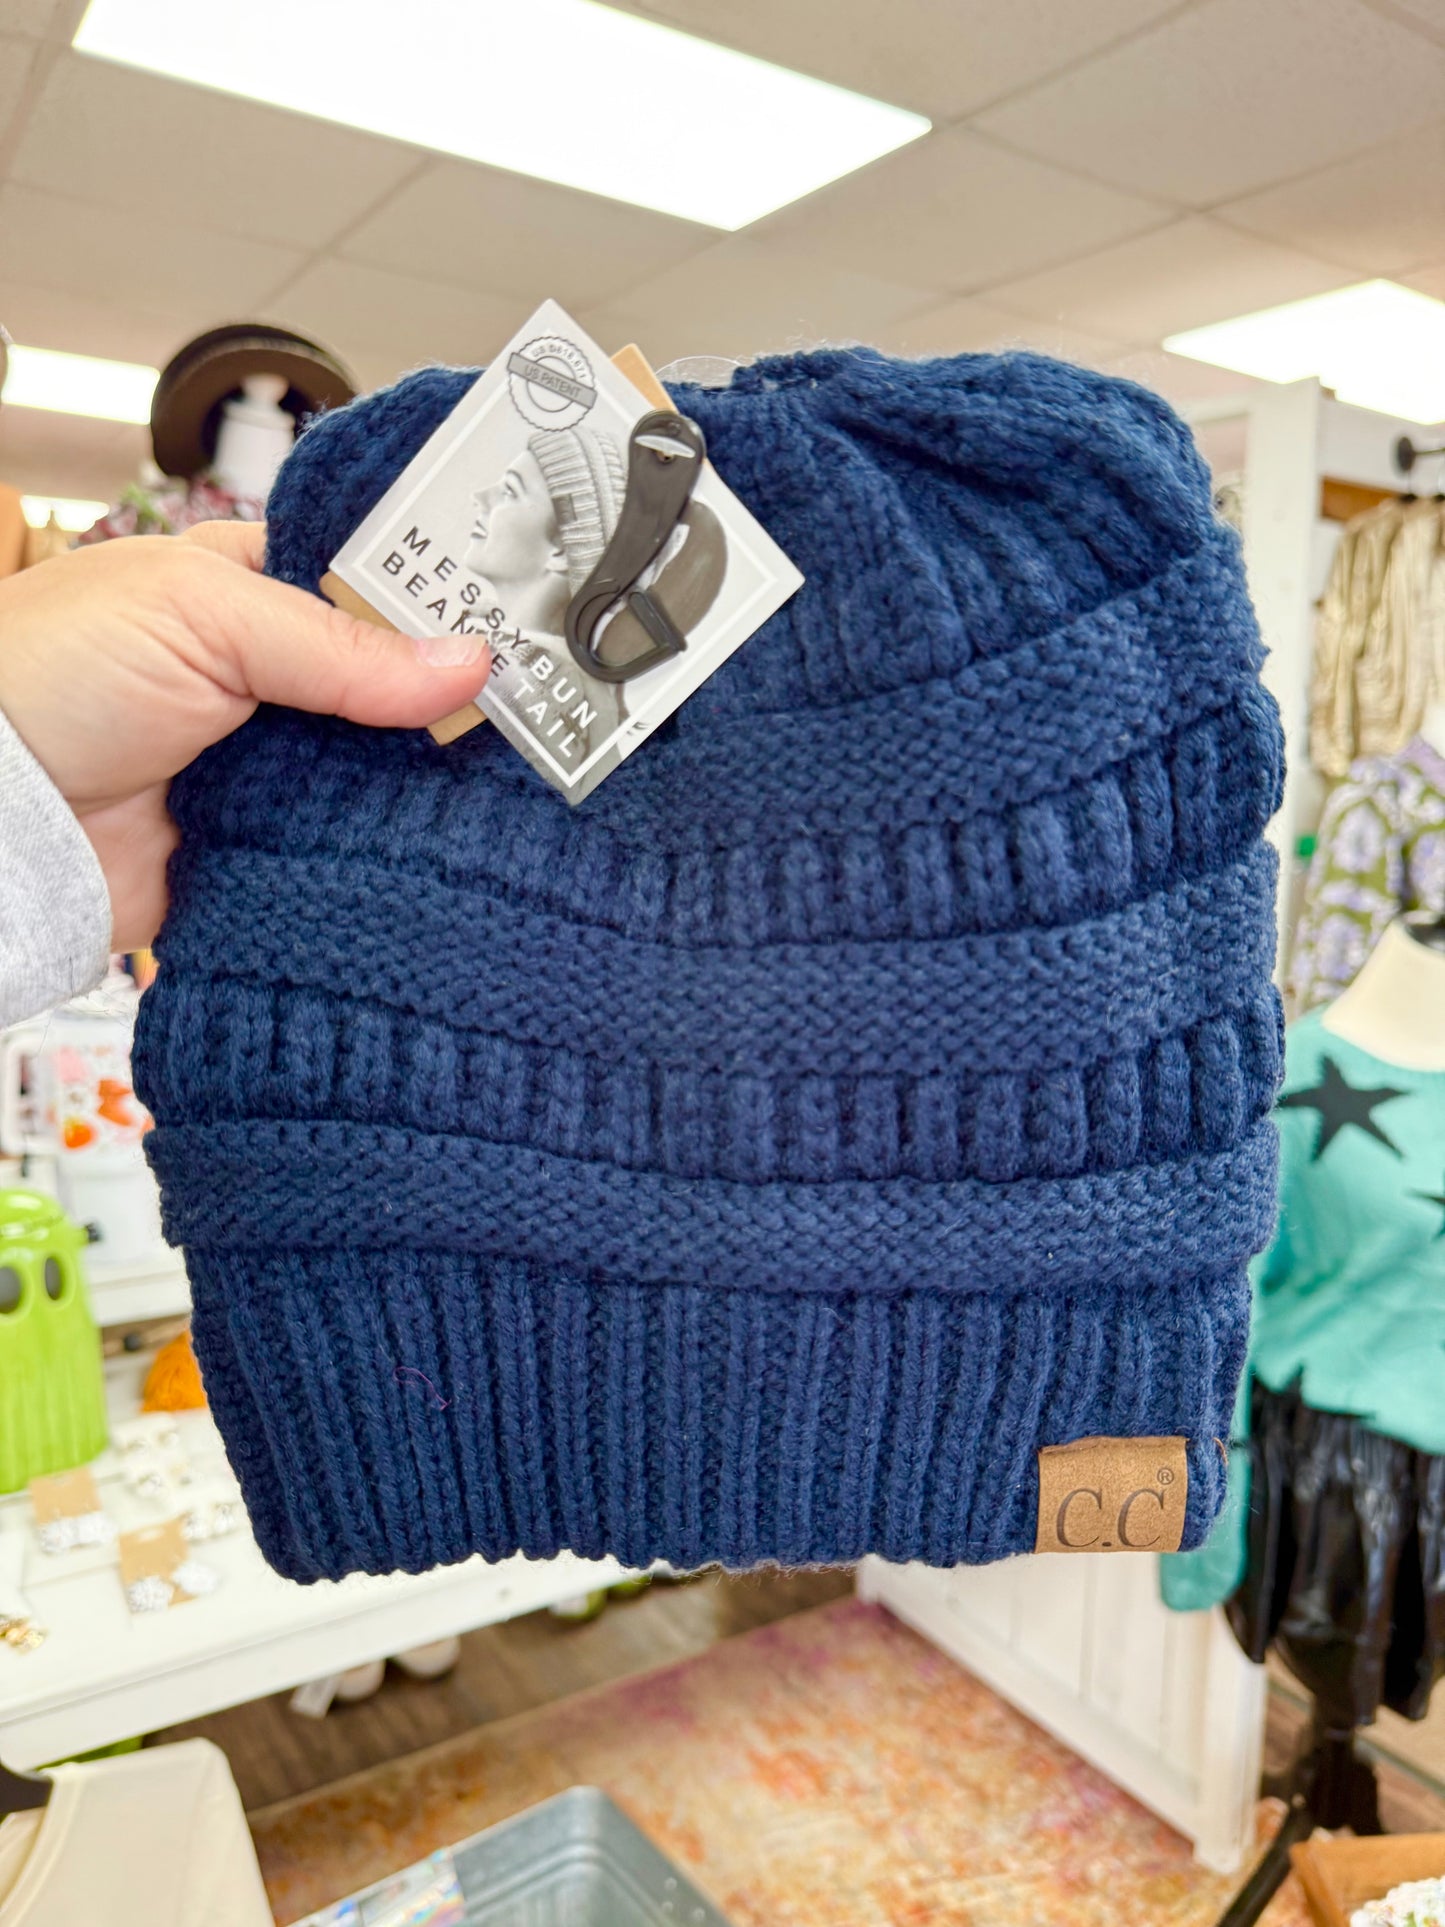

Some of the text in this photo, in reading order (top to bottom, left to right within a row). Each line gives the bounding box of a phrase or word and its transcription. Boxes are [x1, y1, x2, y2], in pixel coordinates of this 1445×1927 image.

[524, 364, 581, 398] US PATENT
[382, 551, 576, 758] BEANE TAIL
[402, 525, 597, 729] MESSY BUN
